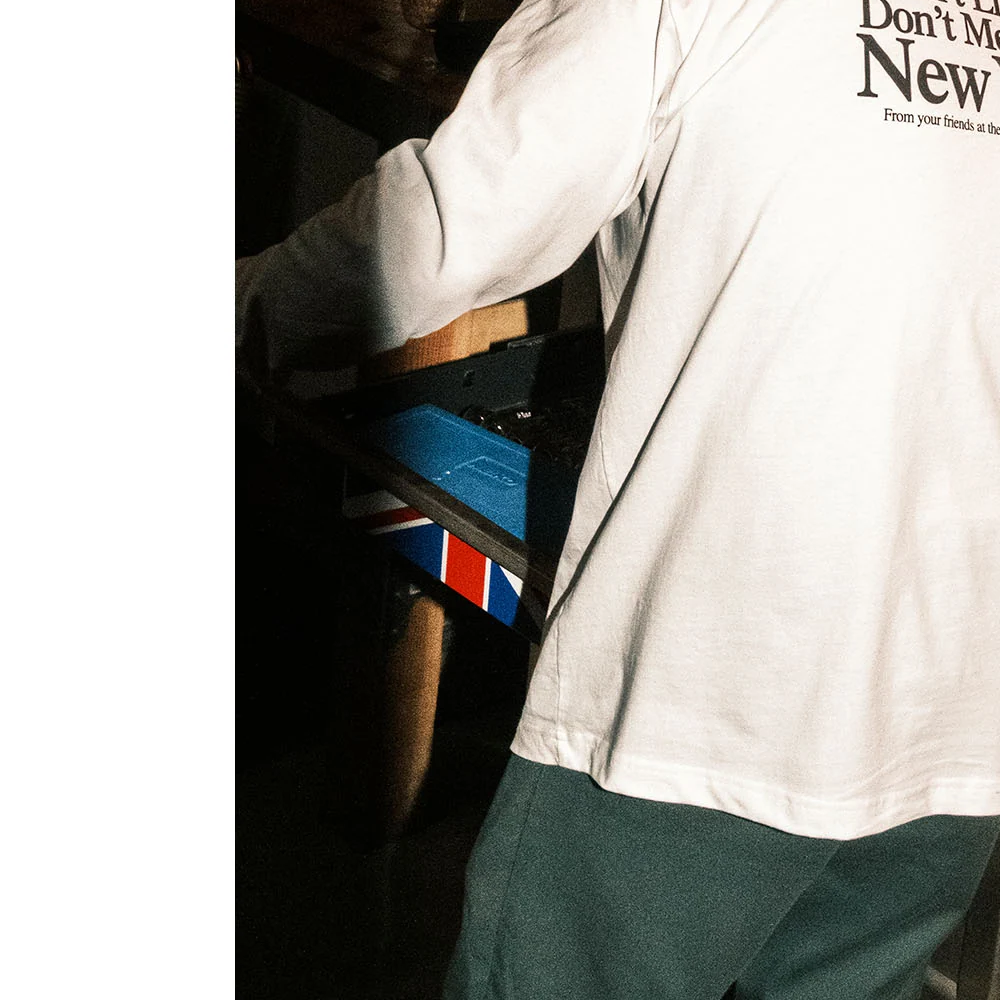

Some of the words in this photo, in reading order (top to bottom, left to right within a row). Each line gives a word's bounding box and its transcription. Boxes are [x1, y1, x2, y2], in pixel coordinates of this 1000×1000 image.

[856, 33, 991, 113] New
[884, 108, 915, 123] From
[917, 114, 942, 129] your
[943, 114, 975, 133] friends
[977, 122, 986, 133] at
[987, 122, 1000, 136] the
